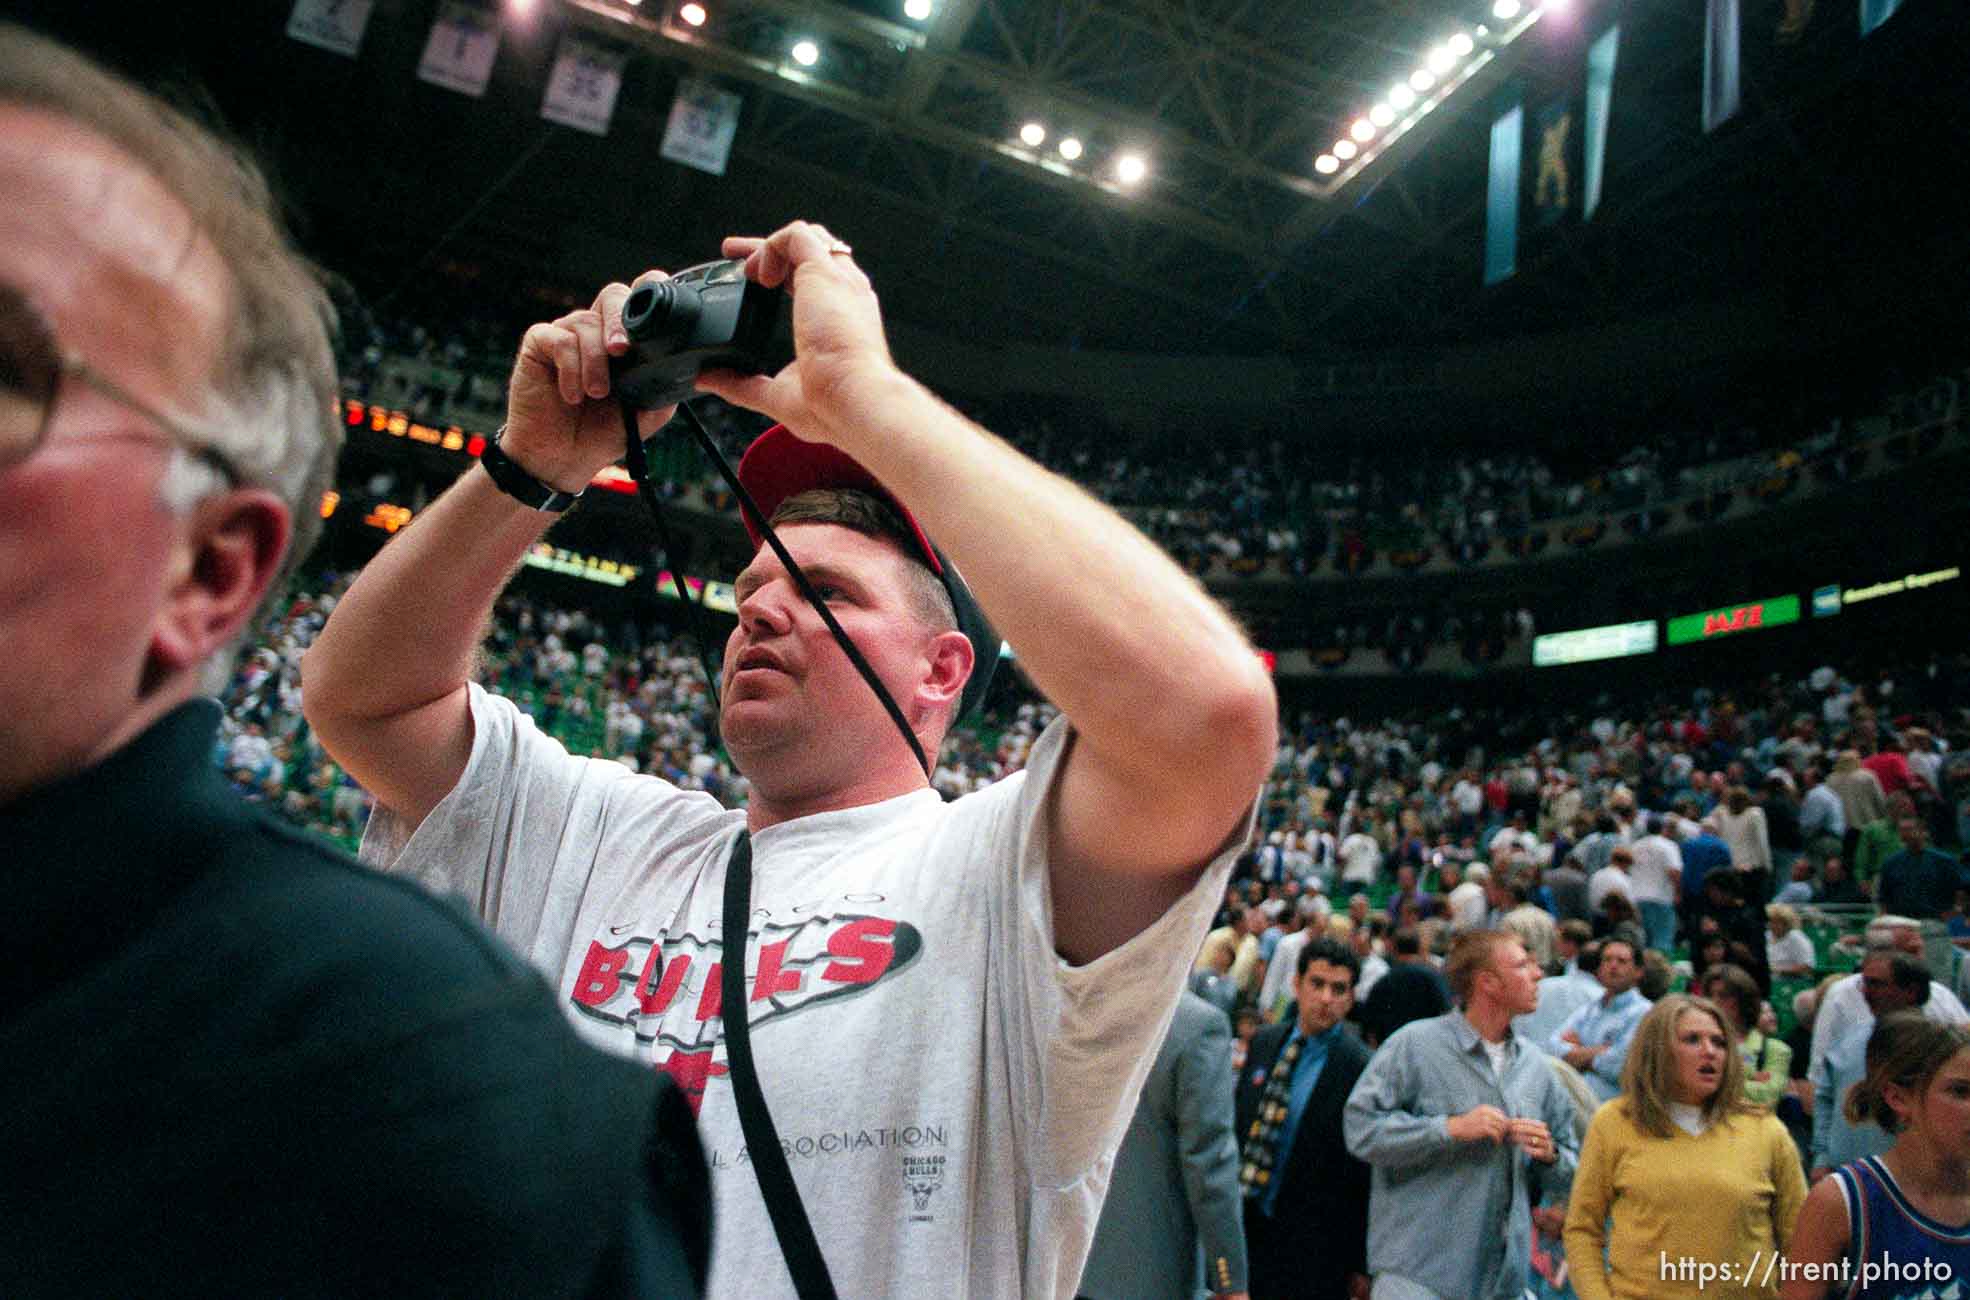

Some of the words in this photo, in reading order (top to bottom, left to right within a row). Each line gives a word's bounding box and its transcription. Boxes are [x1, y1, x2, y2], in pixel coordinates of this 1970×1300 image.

[1703, 605, 1764, 635] JAZZ
[572, 918, 898, 1021] BULLS
[736, 1125, 946, 1163] ASOCIATION
[903, 1155, 946, 1166] CHICAGO
[909, 1166, 938, 1176] BULLS
